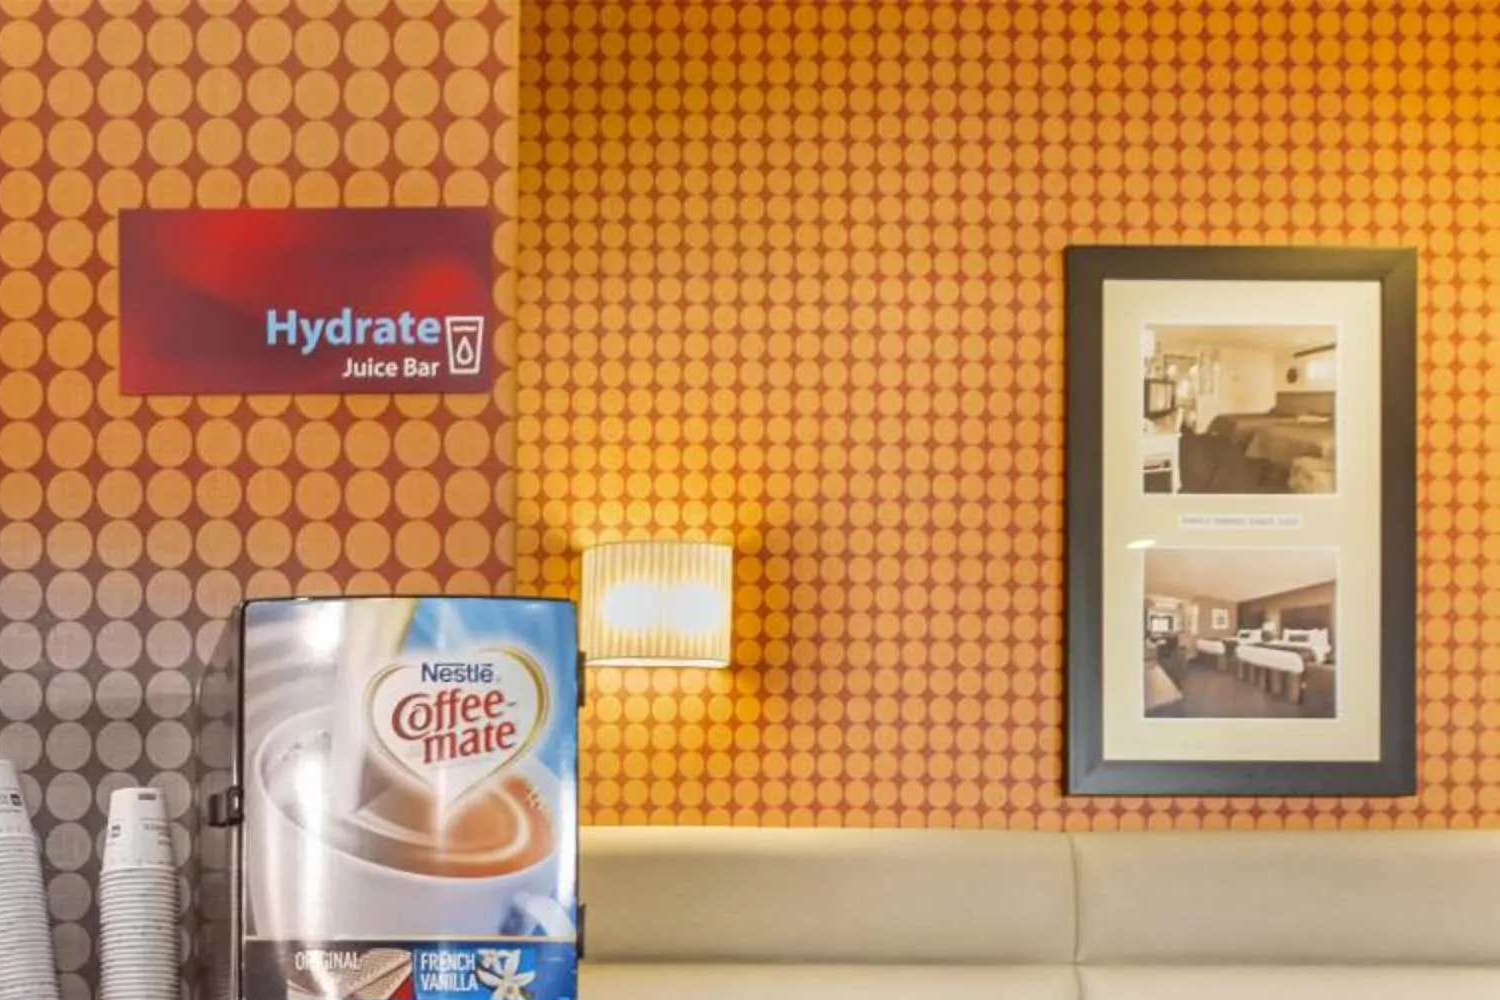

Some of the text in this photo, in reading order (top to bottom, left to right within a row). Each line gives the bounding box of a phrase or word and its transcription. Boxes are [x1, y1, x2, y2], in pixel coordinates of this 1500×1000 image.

[266, 307, 440, 355] Hydrate
[342, 357, 439, 379] Juice Bar
[423, 721, 517, 764] mate
[295, 952, 361, 971] ORGINAL
[420, 953, 476, 972] FRENCH
[420, 973, 479, 992] VANILLA
